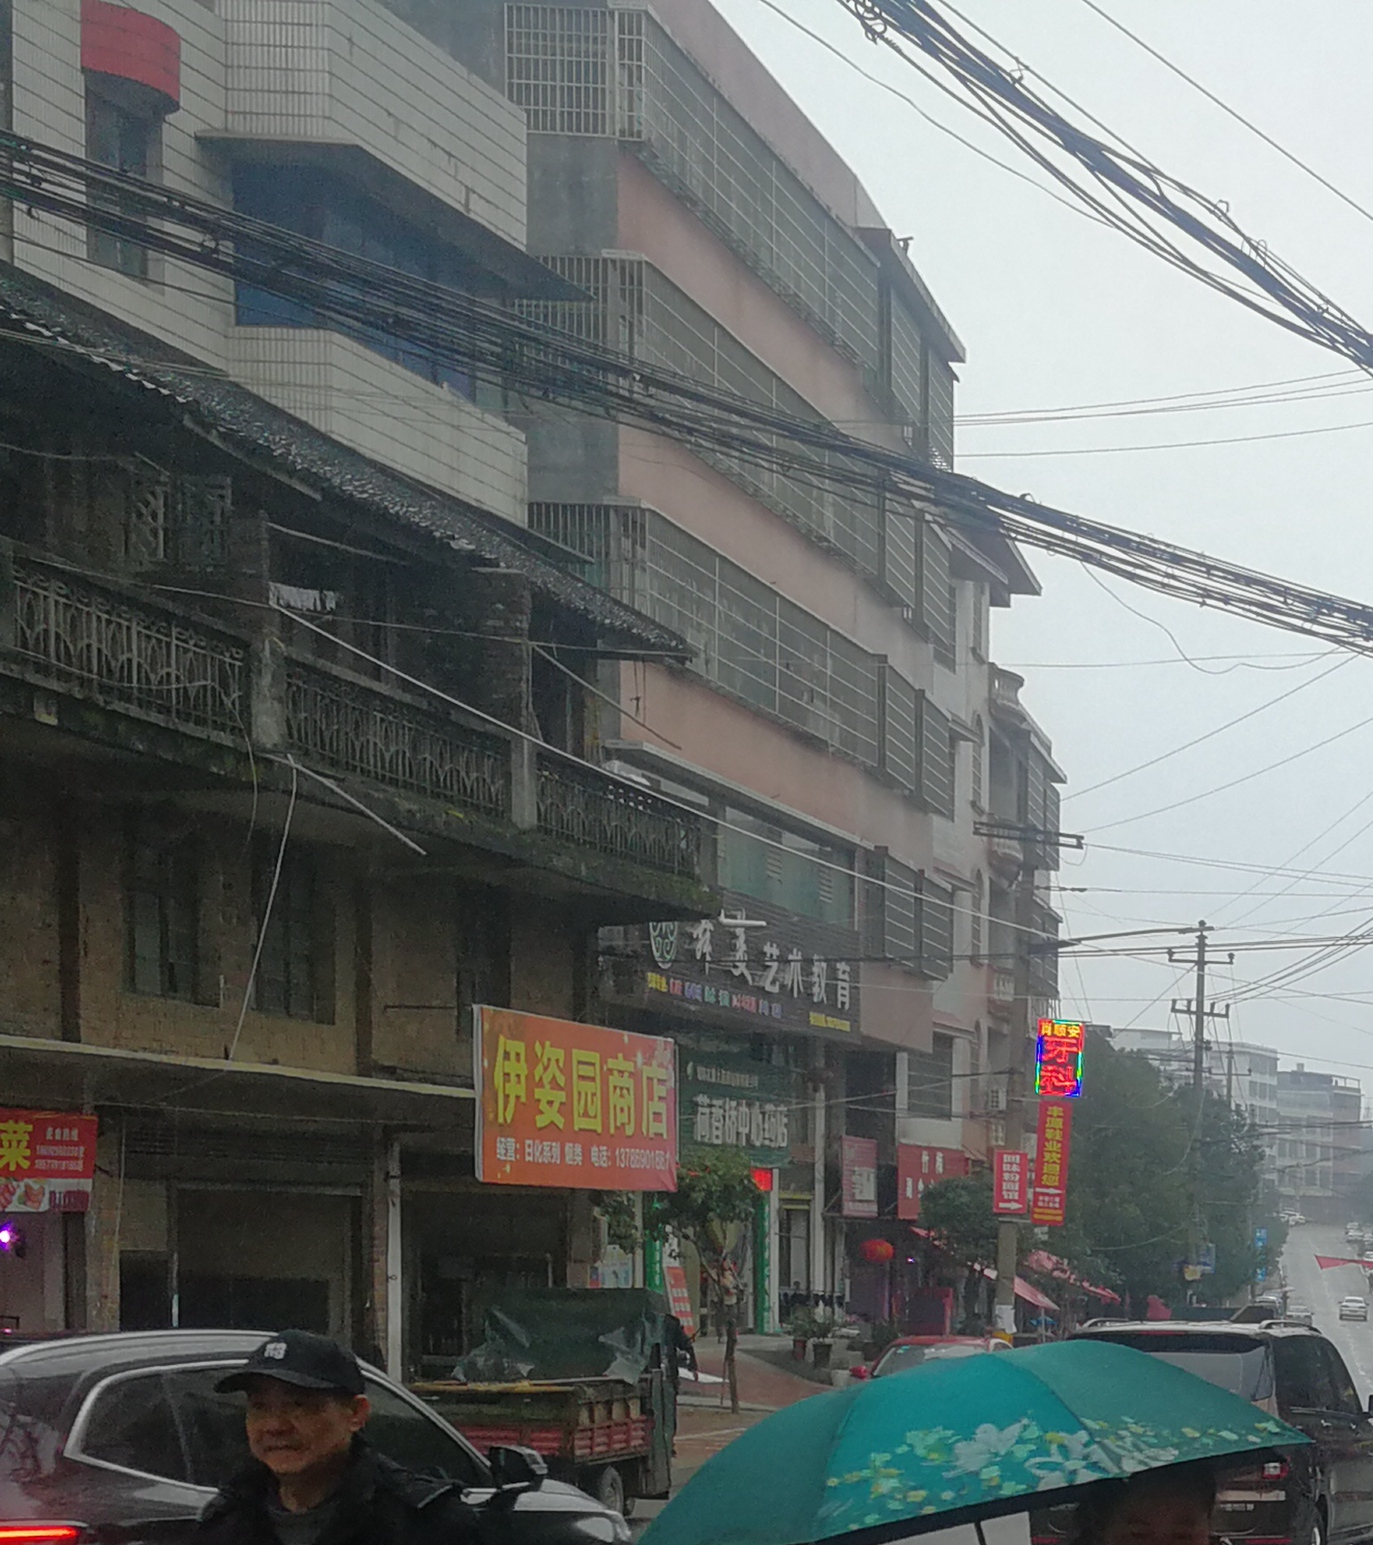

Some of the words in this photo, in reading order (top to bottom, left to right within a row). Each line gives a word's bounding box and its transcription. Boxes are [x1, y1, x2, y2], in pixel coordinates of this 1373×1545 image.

[494, 1035, 668, 1140] 伊姿园商店
[1040, 1036, 1078, 1093] 牙科
